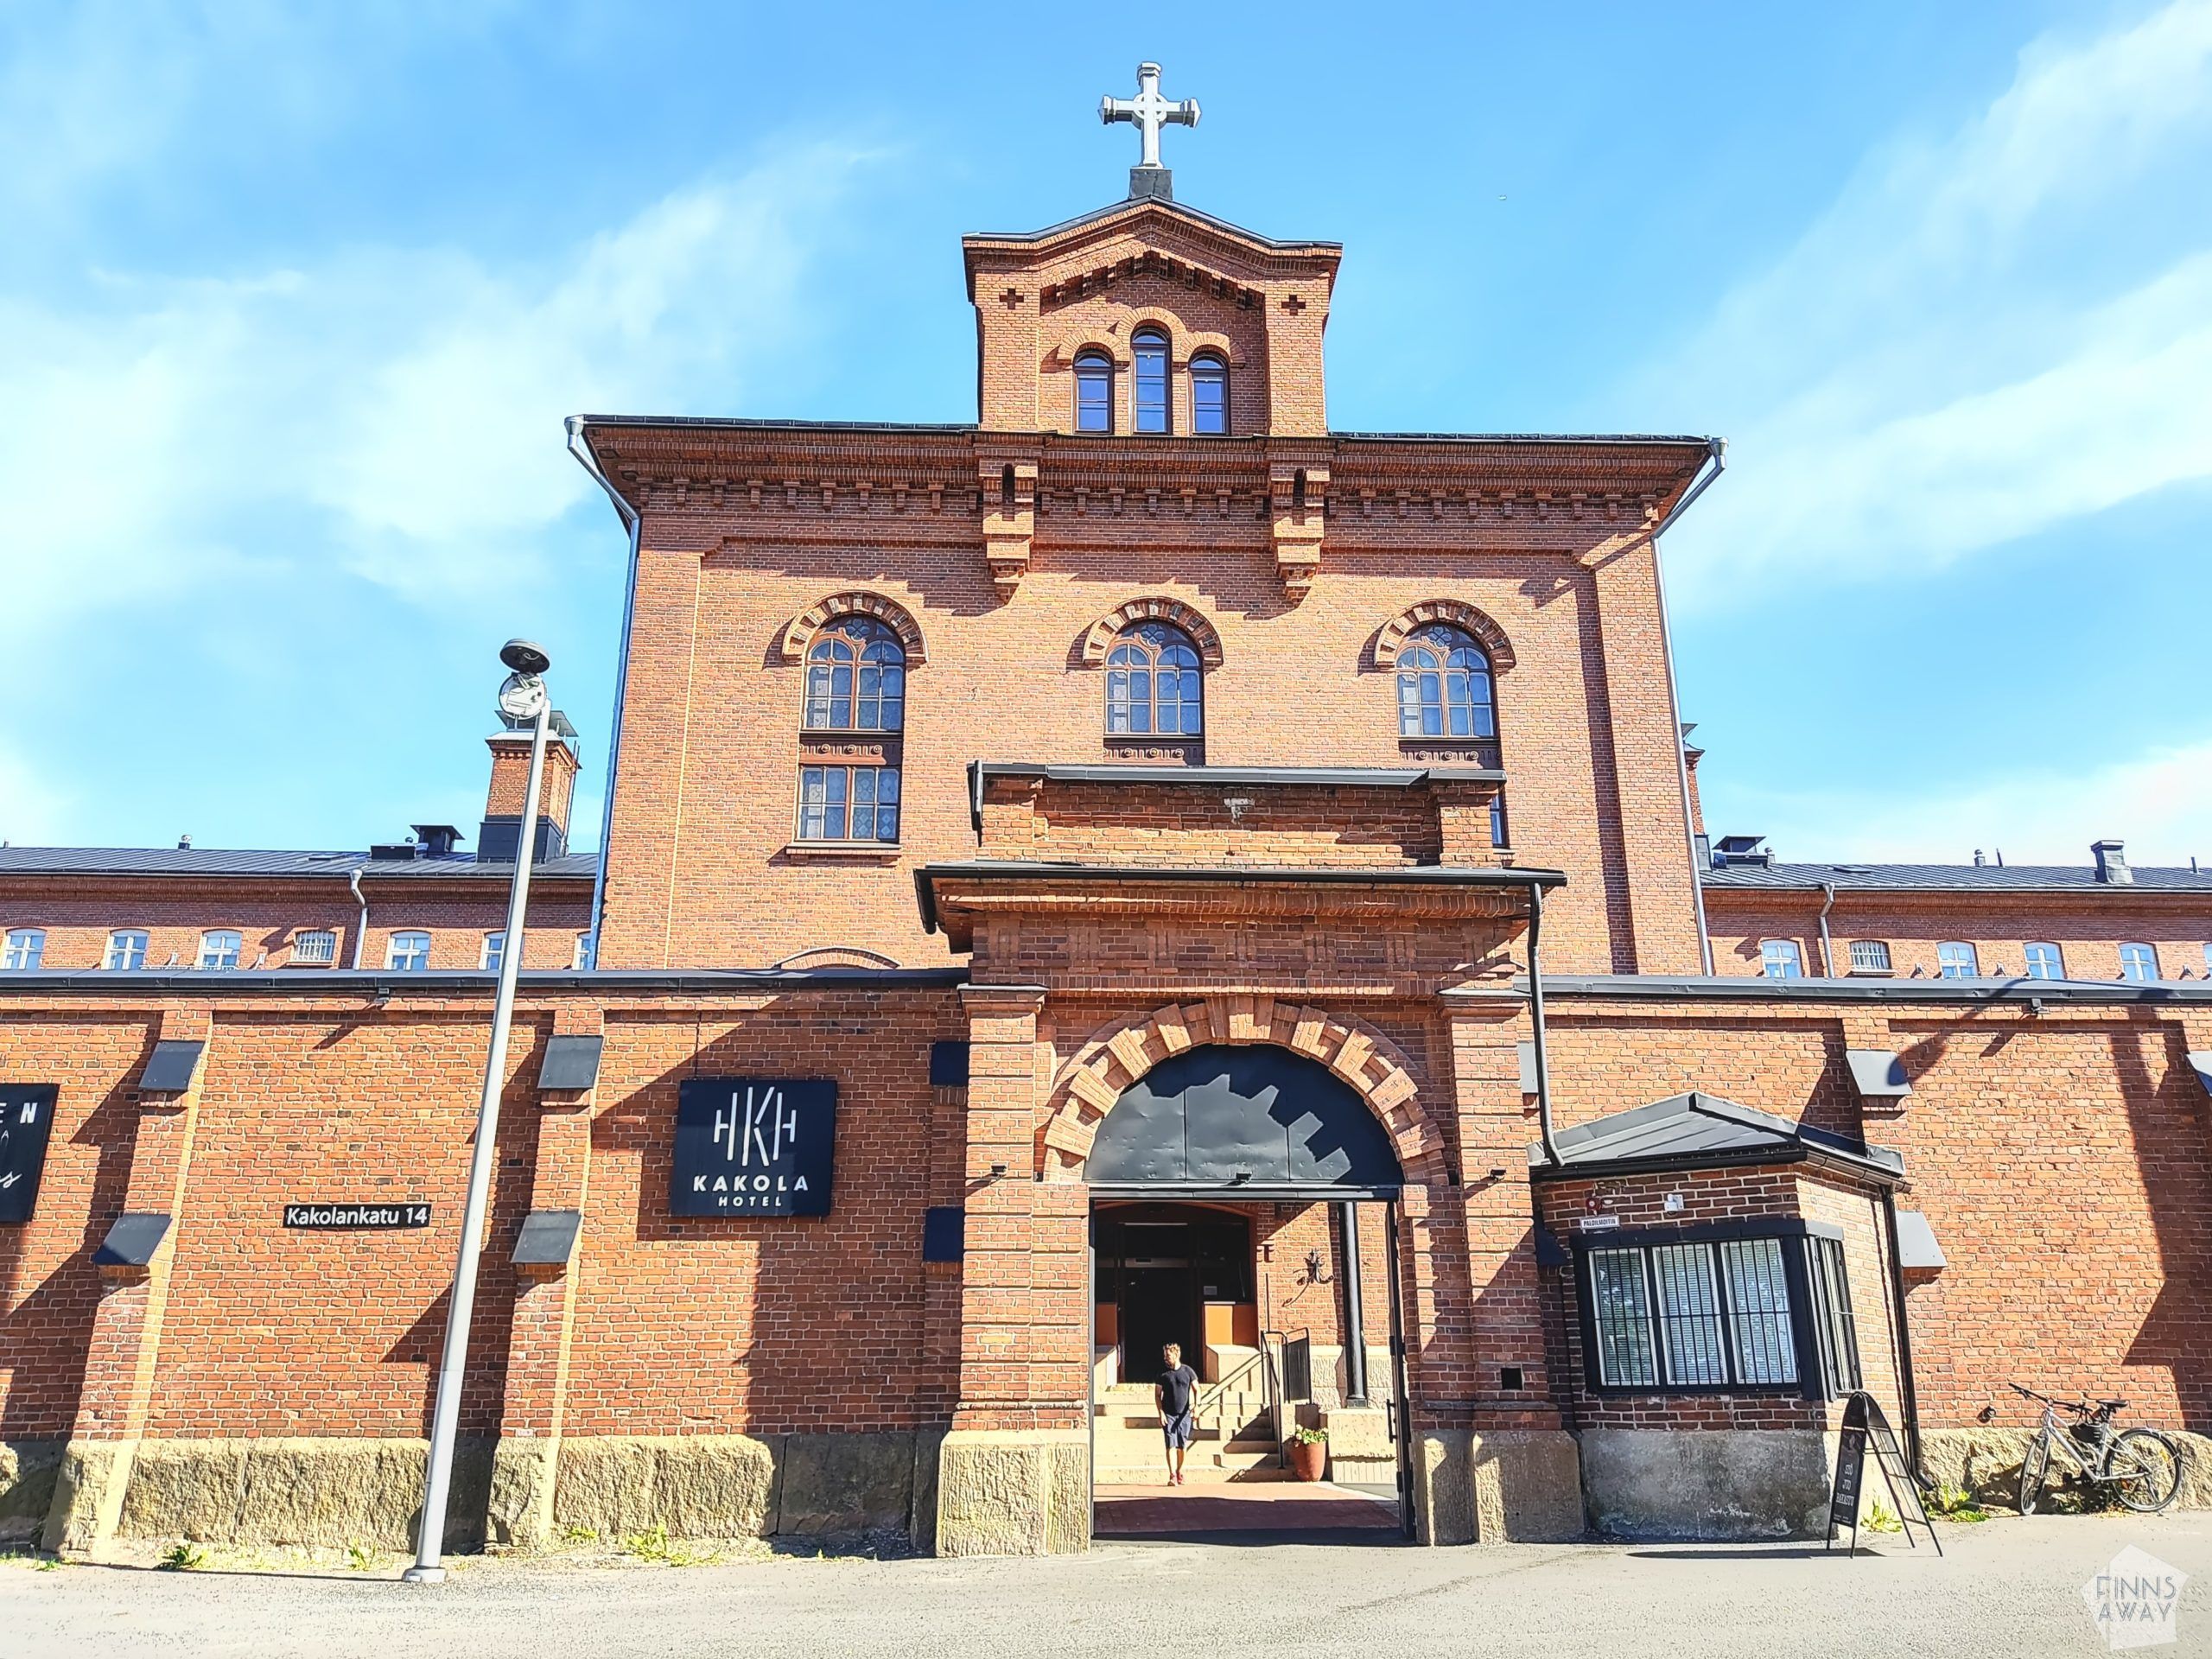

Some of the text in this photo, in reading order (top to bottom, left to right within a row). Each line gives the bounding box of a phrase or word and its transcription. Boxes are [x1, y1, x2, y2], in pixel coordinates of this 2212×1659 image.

[693, 1175, 809, 1192] KAKOLA
[718, 1196, 782, 1207] HOTEL
[286, 1206, 428, 1225] Kakolankatu 14
